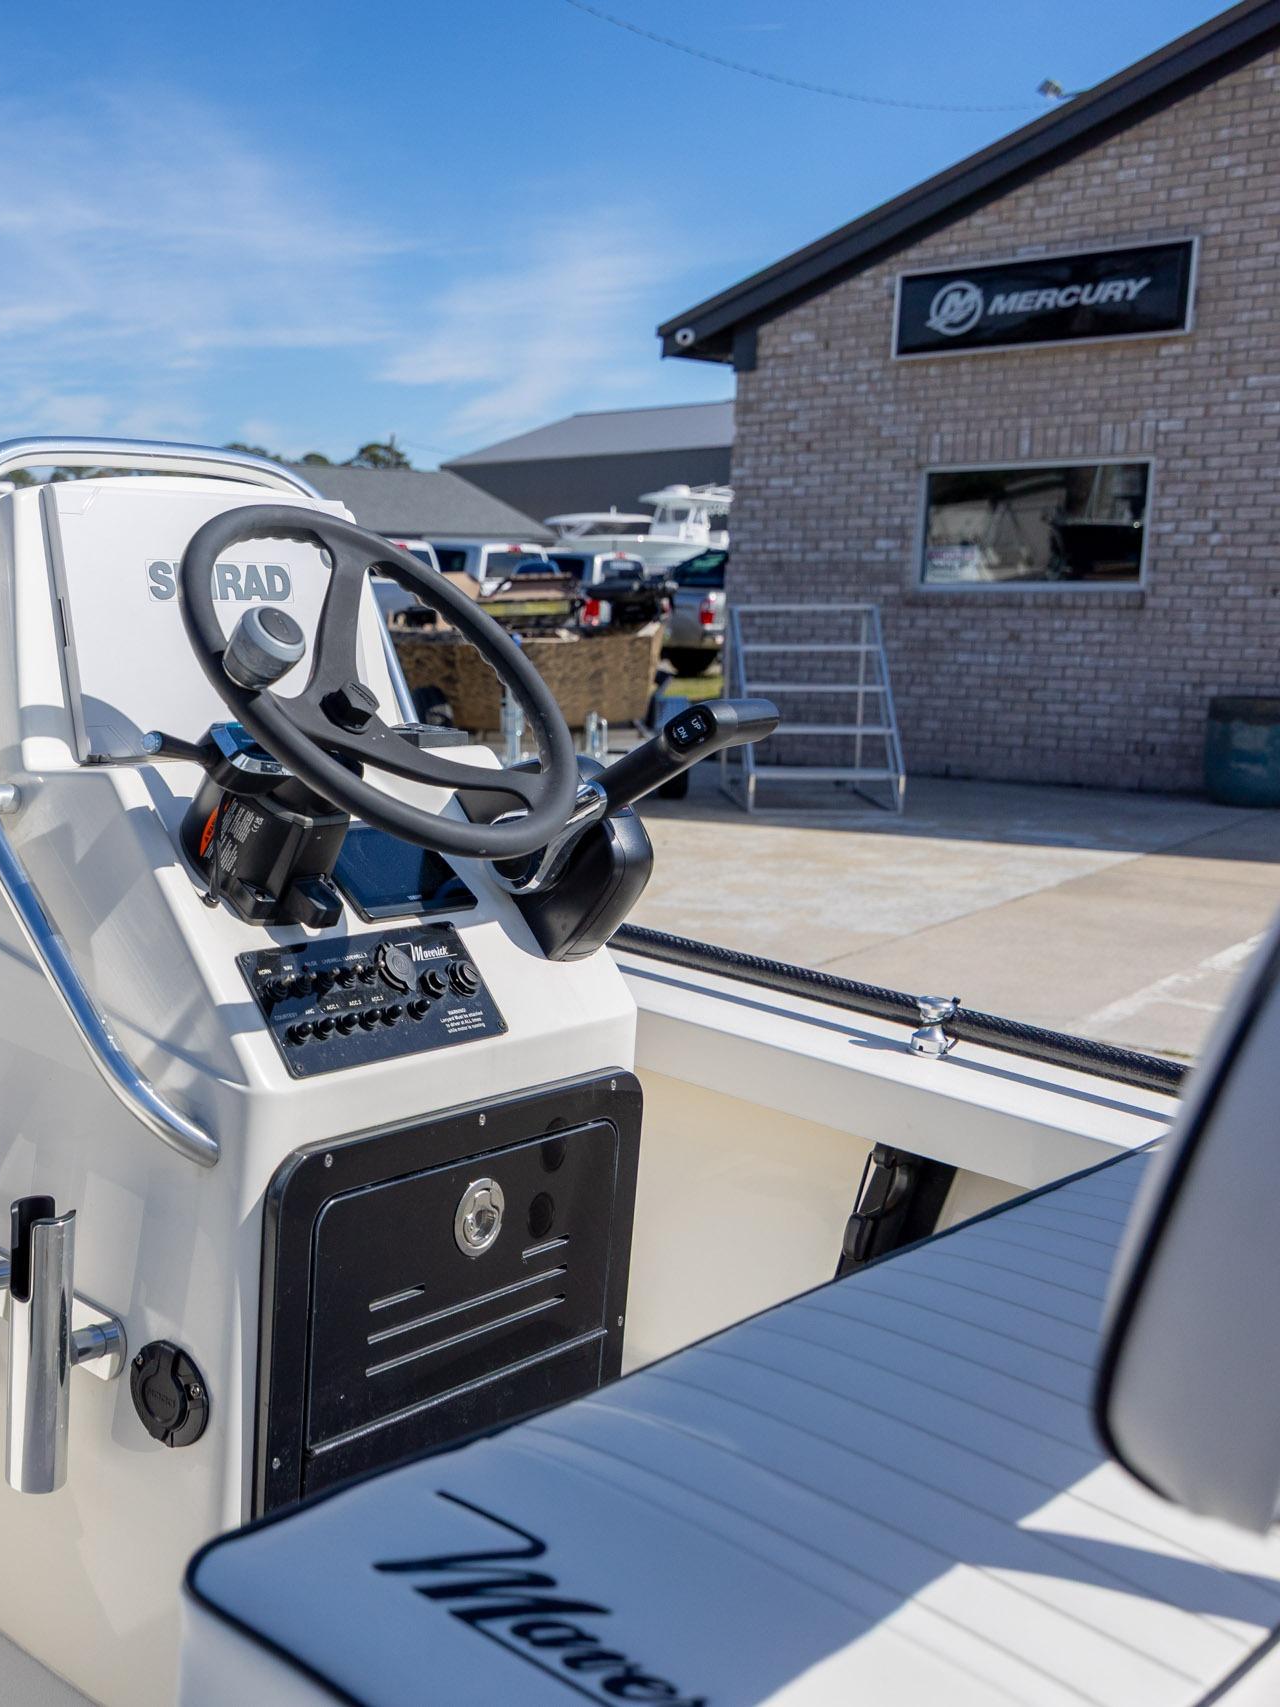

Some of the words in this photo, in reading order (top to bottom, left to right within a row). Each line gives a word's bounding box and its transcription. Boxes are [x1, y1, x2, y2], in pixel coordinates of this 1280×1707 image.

[987, 277, 1151, 316] MERCURY
[149, 561, 291, 601] SRAD
[677, 726, 688, 739] DN
[691, 718, 702, 730] UP
[395, 942, 457, 962] Maverick
